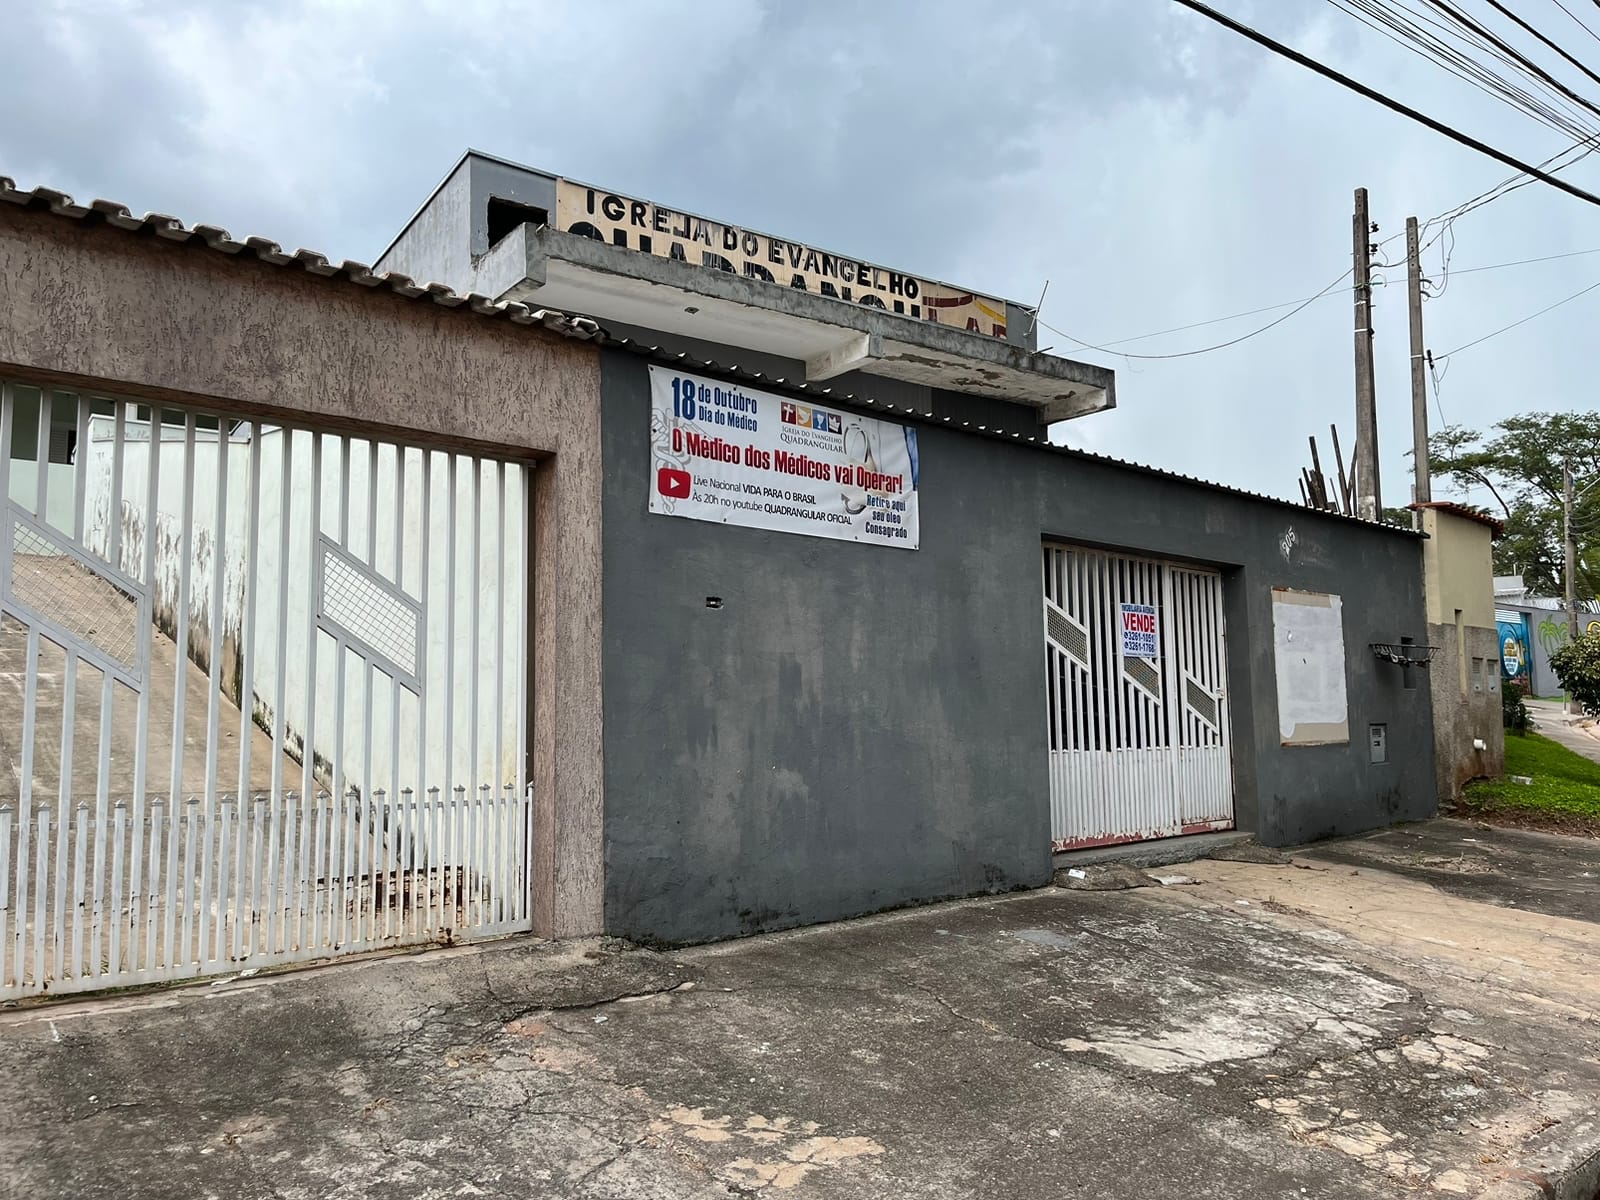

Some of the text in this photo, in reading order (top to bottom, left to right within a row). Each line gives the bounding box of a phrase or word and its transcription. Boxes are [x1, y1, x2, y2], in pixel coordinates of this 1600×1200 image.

[587, 190, 711, 246] IGREJA
[722, 228, 759, 257] DO
[768, 239, 919, 299] EVANGELHO
[671, 377, 758, 420] 18 de Outubro
[698, 405, 758, 432] Dia do Médico
[780, 432, 844, 453] QUADRANGULAR
[782, 426, 843, 444] IGREJA DO EVANGELHO
[672, 428, 903, 494] O Médico dos Médicos vai Operar!
[693, 474, 817, 505] Live Nacional VIDA PARA O BRASIL
[692, 488, 852, 525] Às 20h no youtube QUADRANGULAR OFICIAL
[867, 494, 906, 512] Retire aqui
[872, 510, 885, 522] seu
[865, 521, 908, 538] Consagrado
[1122, 611, 1156, 634] VENDE
